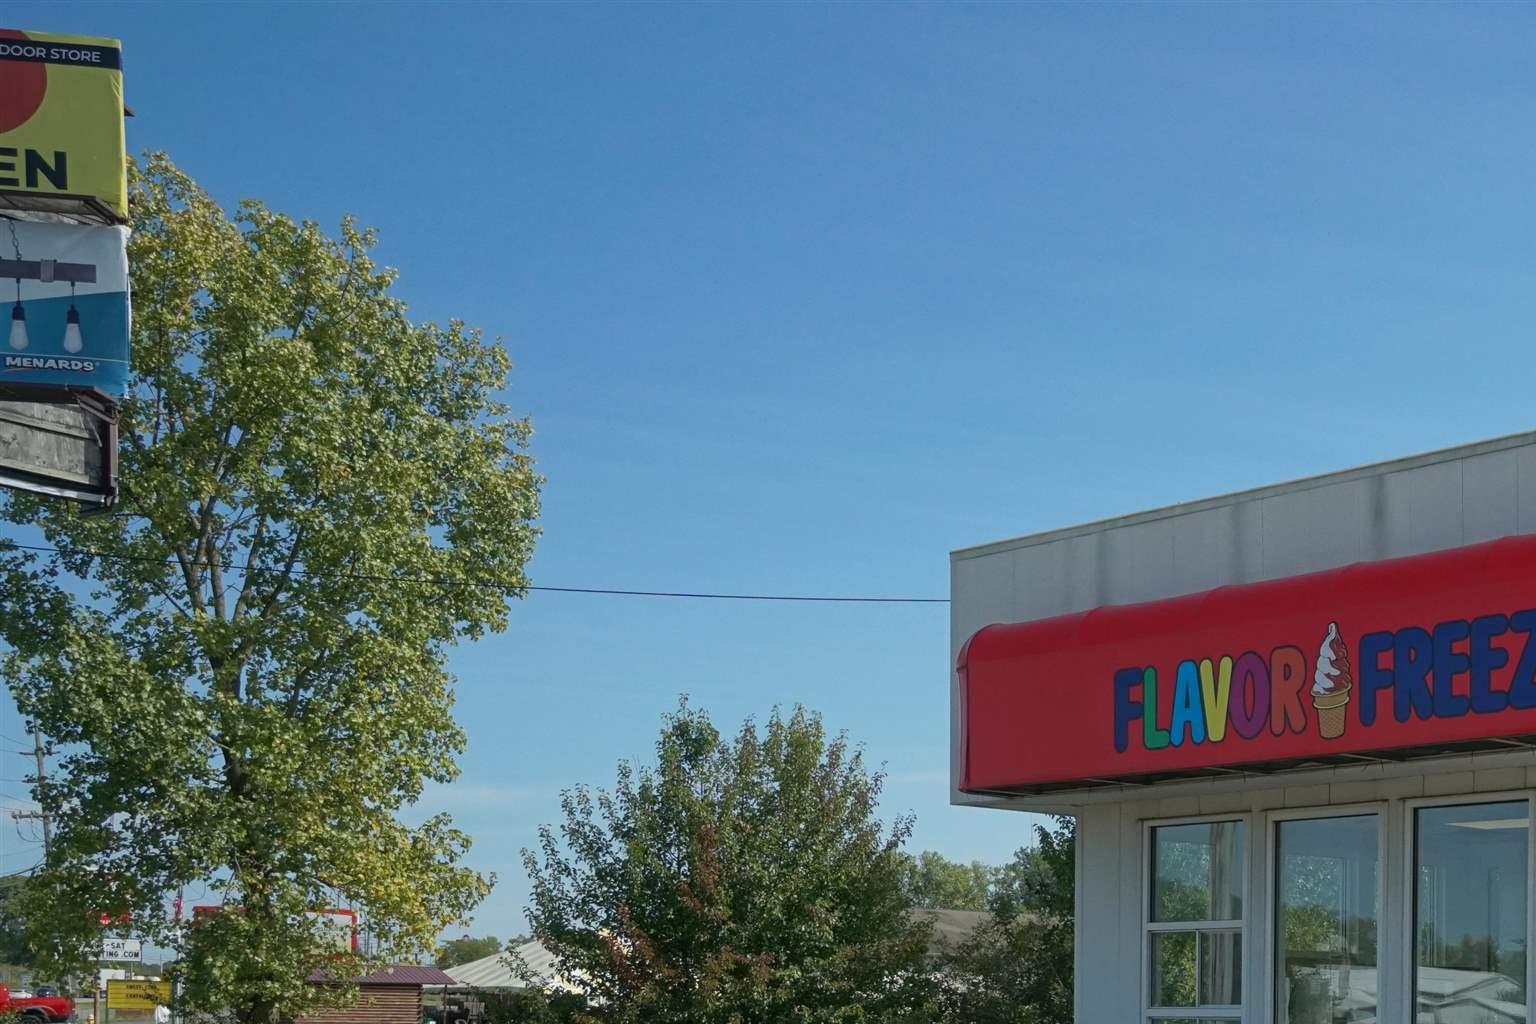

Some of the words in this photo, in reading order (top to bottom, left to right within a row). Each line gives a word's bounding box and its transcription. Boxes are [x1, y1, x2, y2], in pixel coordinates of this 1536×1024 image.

[50, 48, 101, 62] STORE
[5, 356, 95, 371] MENARDS
[1113, 646, 1307, 753] FLAVOR
